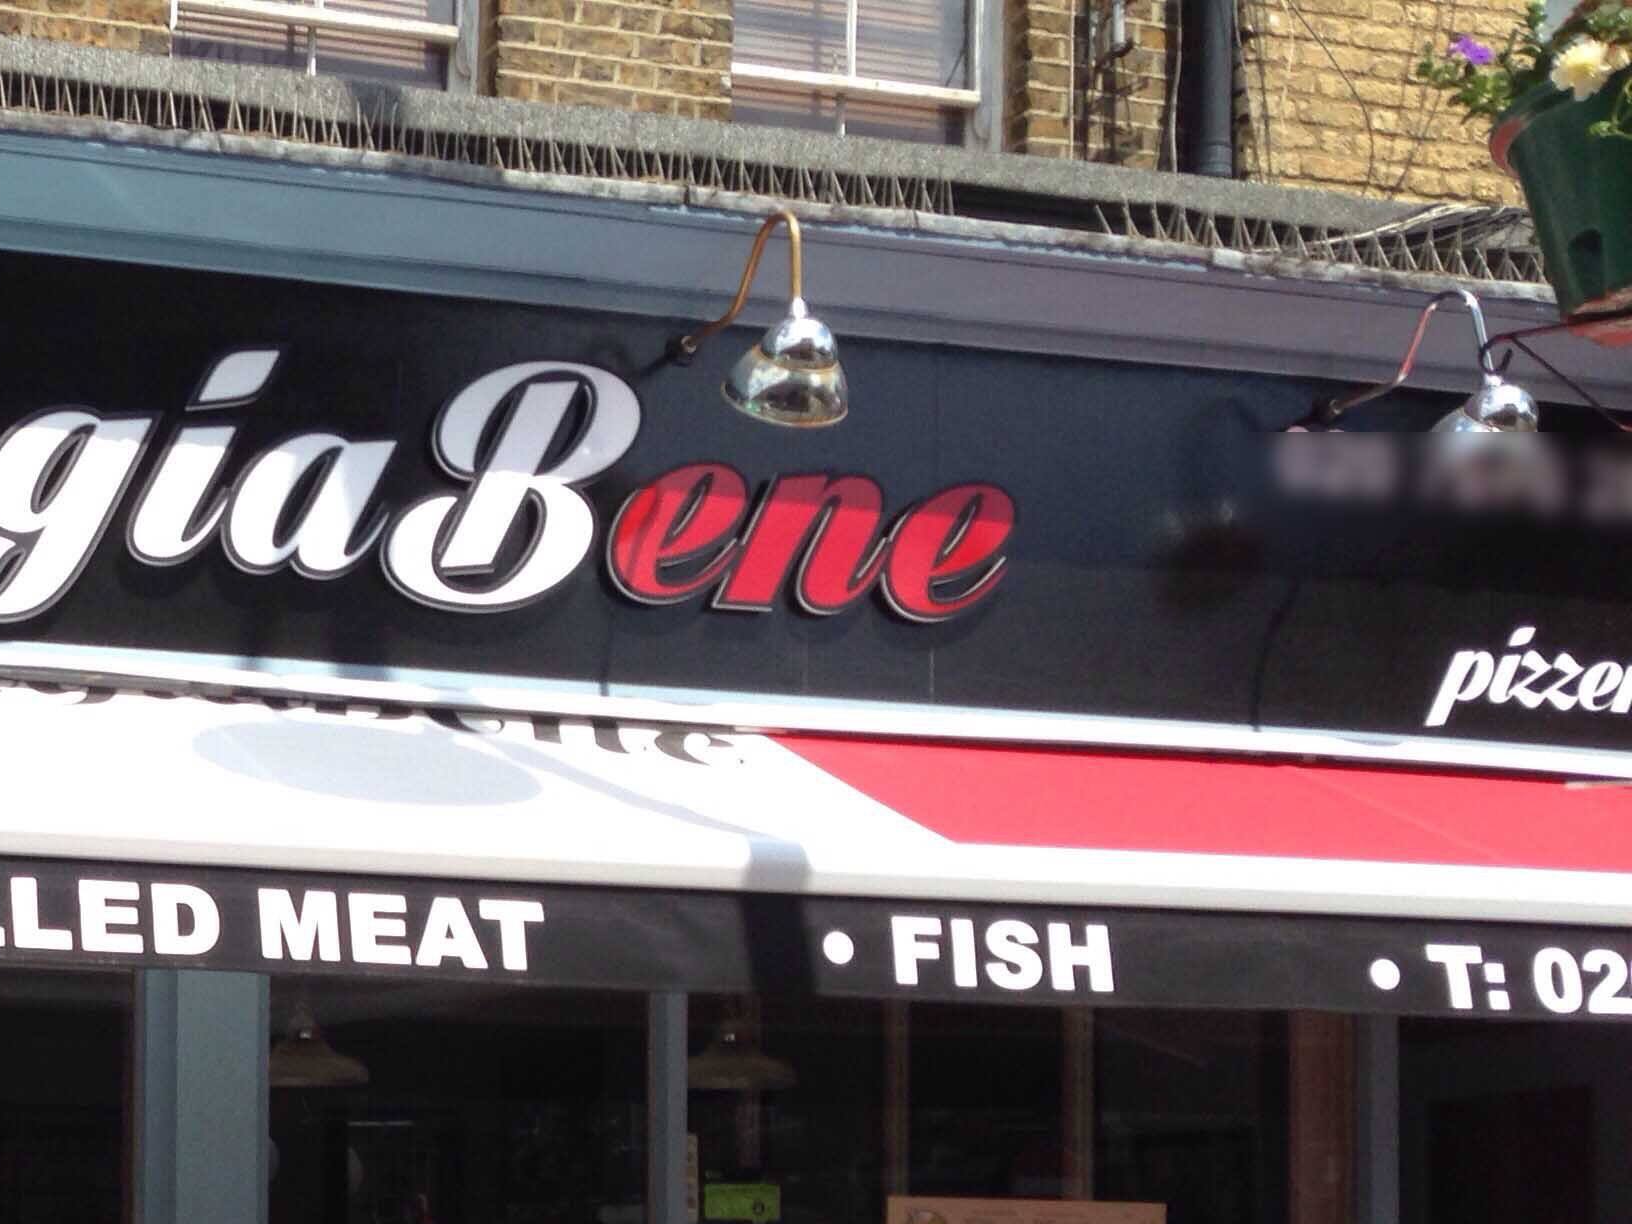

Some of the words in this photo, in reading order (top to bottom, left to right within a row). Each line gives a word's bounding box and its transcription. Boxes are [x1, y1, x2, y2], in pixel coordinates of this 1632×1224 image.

[257, 886, 546, 972] MEAT
[889, 914, 1115, 994] FISH
[1424, 942, 1512, 1012] T:
[1532, 946, 1632, 1016] 02
